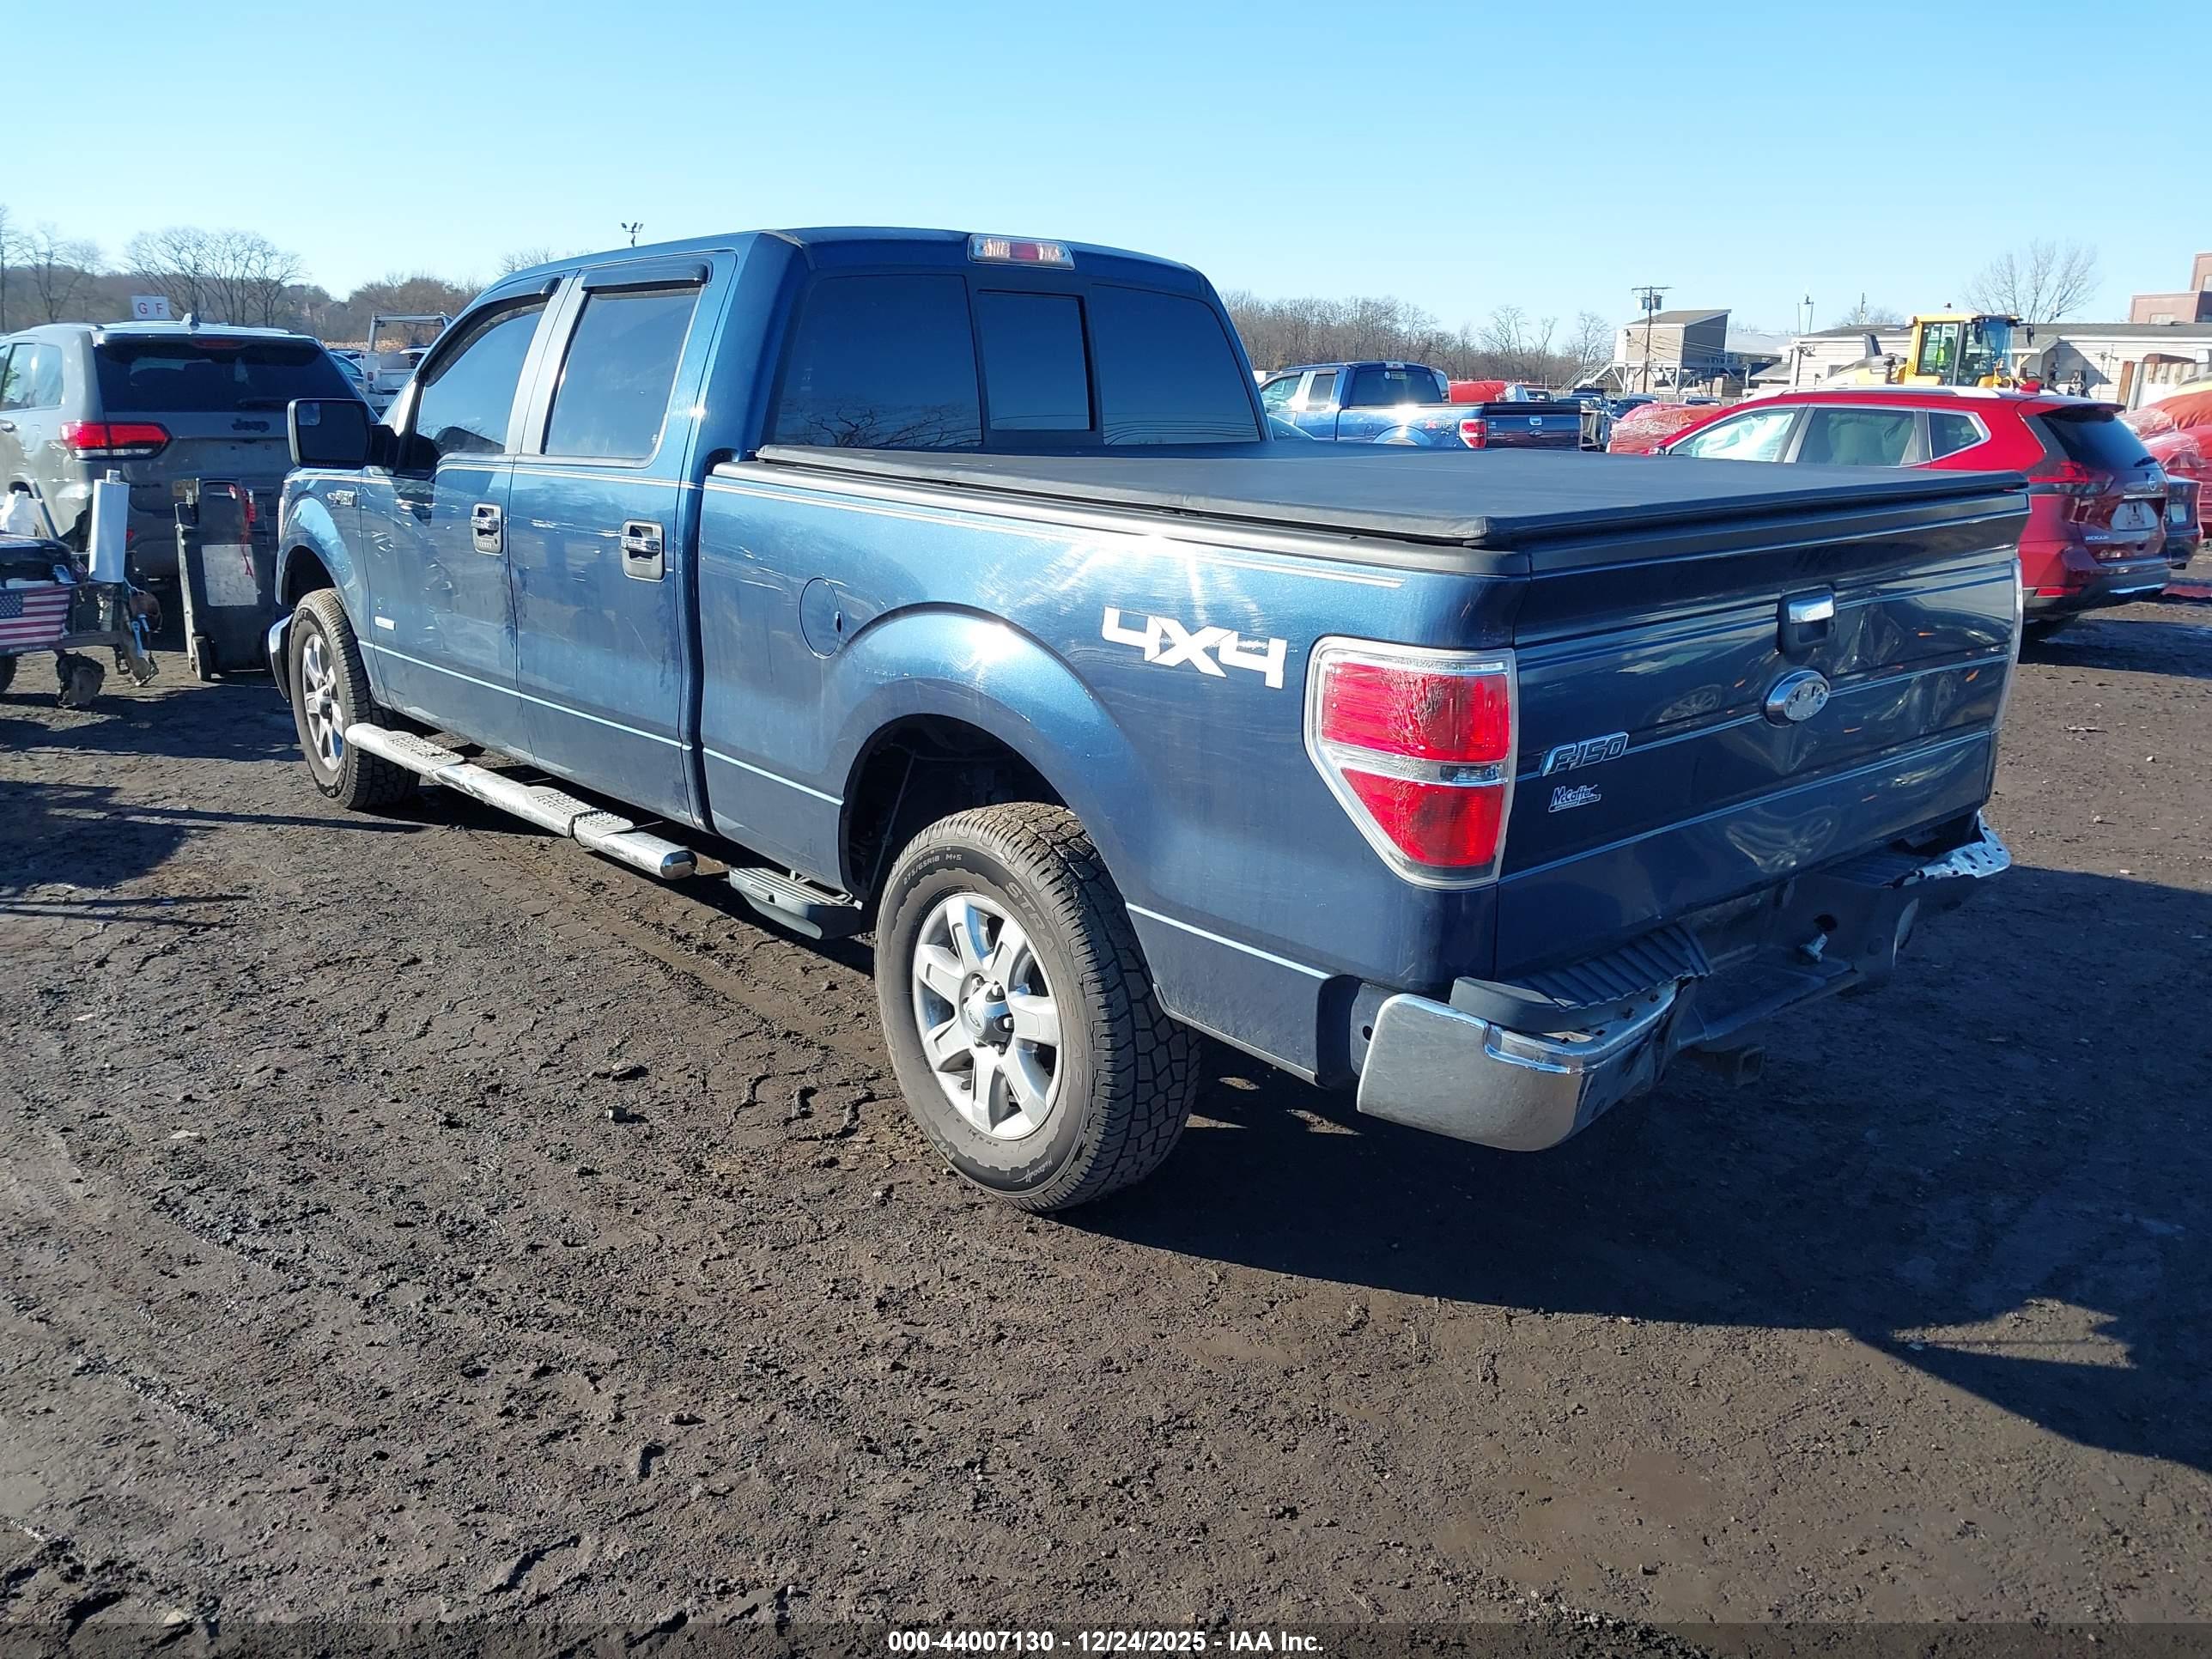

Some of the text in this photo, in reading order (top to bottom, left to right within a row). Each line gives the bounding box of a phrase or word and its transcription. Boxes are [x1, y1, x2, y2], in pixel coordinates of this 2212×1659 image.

[137, 301, 163, 314] G F
[230, 417, 270, 433] Jeep
[1540, 731, 1630, 777] F-150
